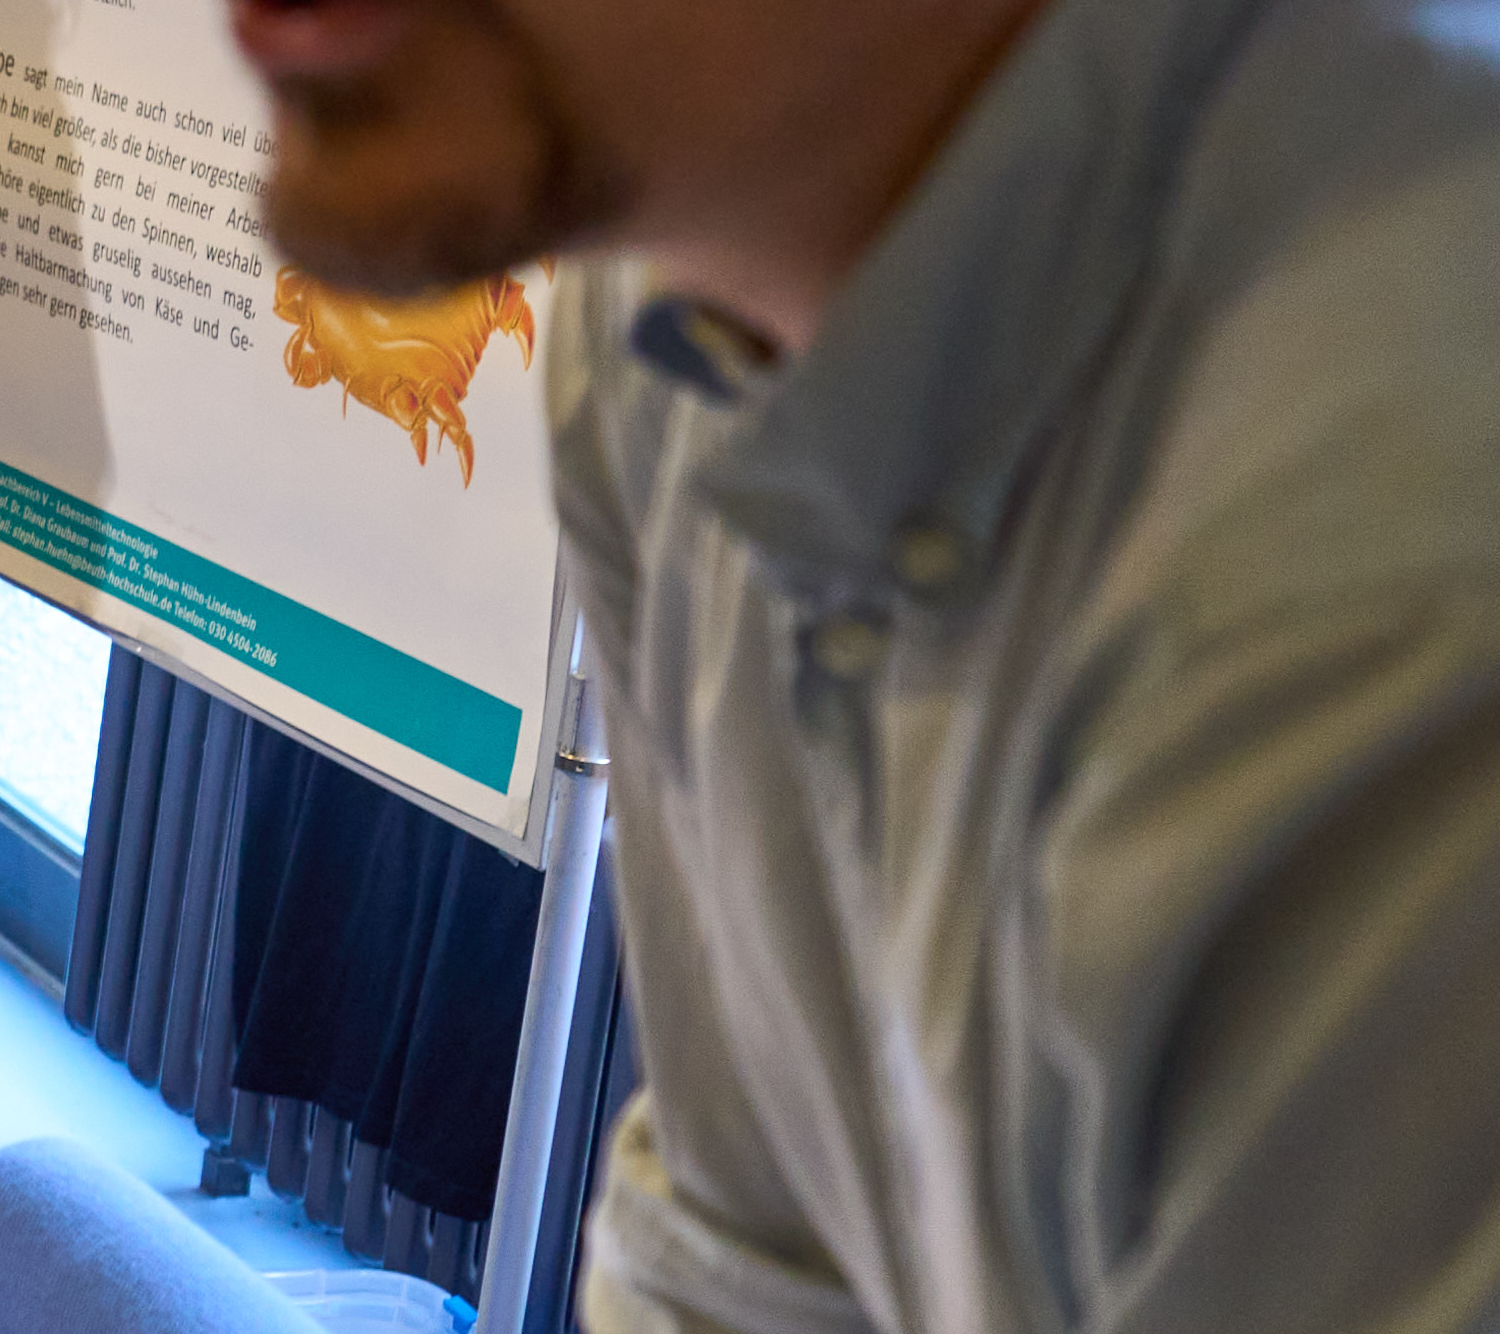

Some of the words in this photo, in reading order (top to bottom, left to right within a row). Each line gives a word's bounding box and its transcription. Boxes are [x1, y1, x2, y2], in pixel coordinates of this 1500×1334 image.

[10, 98, 29, 120] bin
[32, 108, 54, 129] viel
[53, 115, 97, 148] größer,
[101, 129, 118, 151] als
[122, 134, 142, 158] die
[145, 140, 187, 172] bisher
[190, 159, 269, 200] vorgestellte
[23, 65, 48, 91] sagt
[54, 75, 84, 98] mein
[91, 83, 128, 112] Name
[135, 99, 167, 123] auch
[174, 110, 213, 138] schon
[222, 124, 247, 148] viel
[7, 135, 46, 165] kannst
[56, 152, 85, 177] mich
[94, 167, 124, 191] gern
[135, 178, 156, 202] bei
[167, 191, 215, 222] meiner
[18, 213, 40, 236] und
[49, 224, 84, 253] etwas
[92, 241, 142, 278] gruselig
[152, 261, 212, 300] aussehen
[223, 289, 257, 321] mag,
[28, 179, 85, 216] eigentlich
[91, 203, 106, 222] zu
[111, 207, 136, 233] den
[142, 217, 198, 259] Spinnen,
[206, 242, 263, 279] weshalb
[15, 242, 113, 303] Haltbarmachung
[121, 287, 145, 311] von
[155, 296, 184, 327] Käse
[194, 316, 220, 341] und
[230, 326, 255, 352] Ge-
[22, 284, 48, 308] sehr
[50, 296, 77, 318] gern
[79, 306, 134, 344] gesehen.
[56, 500, 158, 560] Lebensmitteltechnologie
[90, 541, 107, 557] und
[107, 545, 127, 569] Prof.
[129, 556, 142, 575] Dr.
[143, 565, 180, 593] Stephan
[181, 581, 257, 632] Hühn-Lindenbein
[174, 600, 207, 631] Telefon:
[208, 620, 227, 643] 030
[227, 630, 278, 668] 4504-2086
